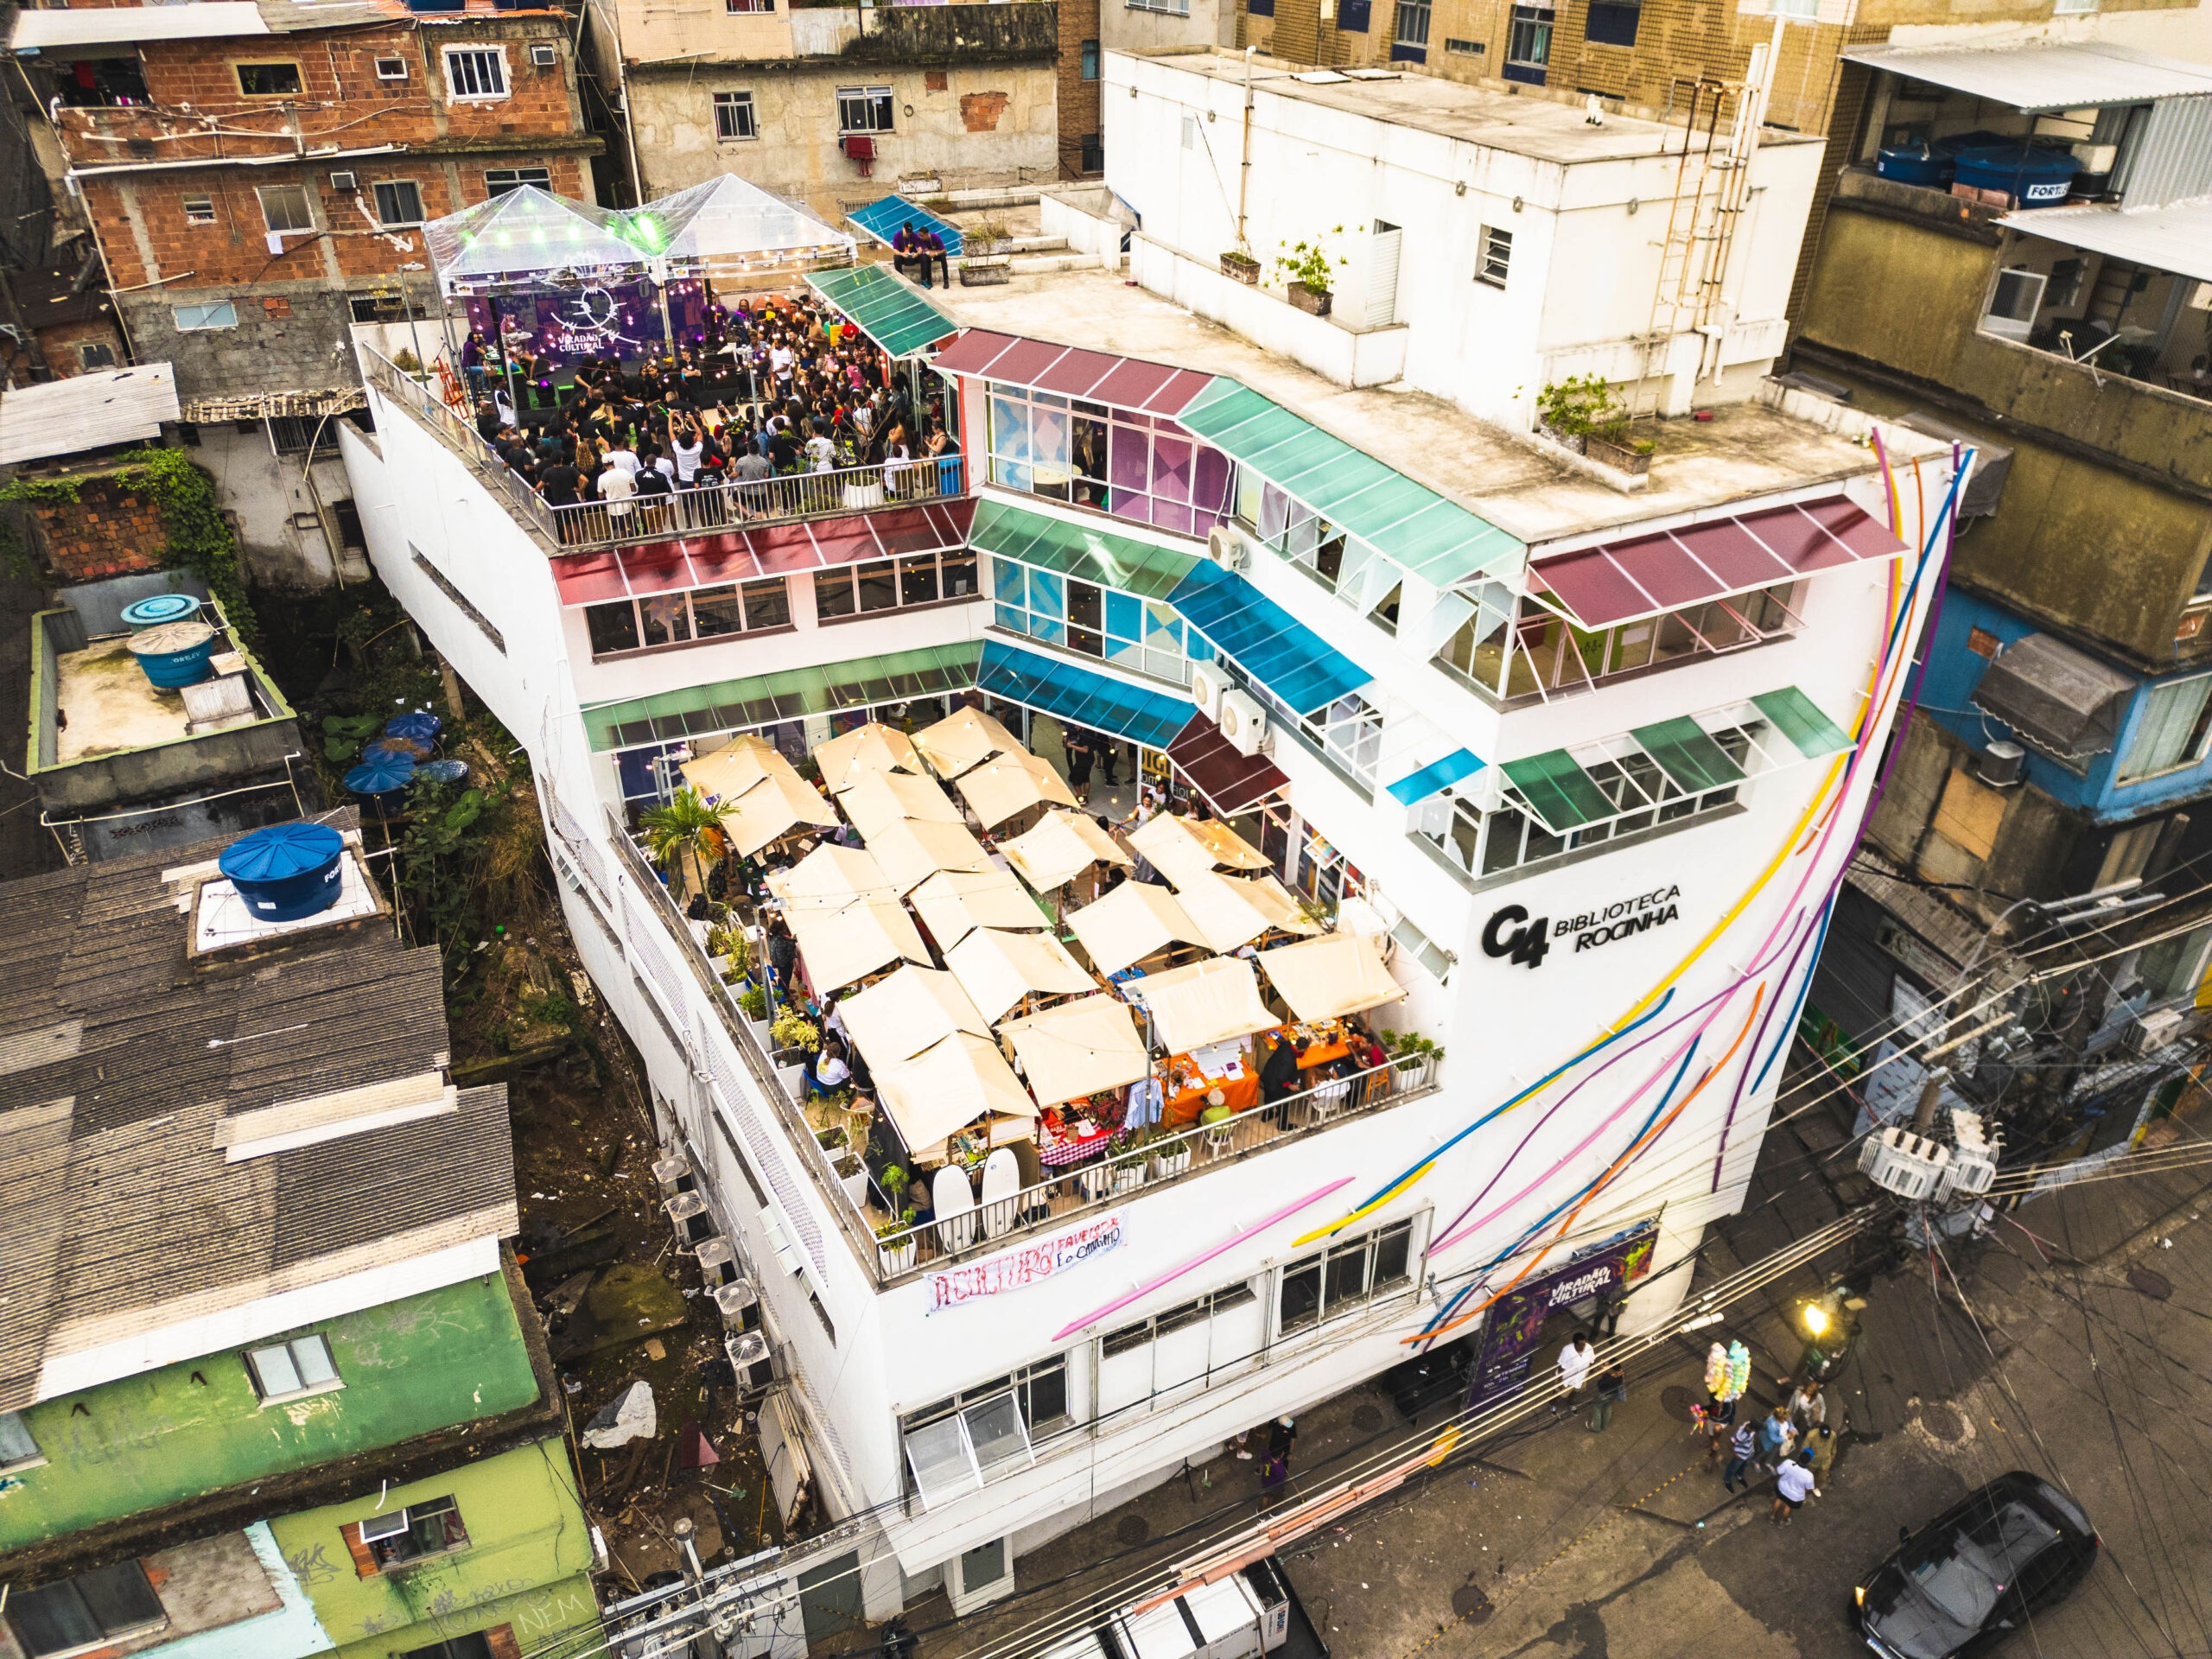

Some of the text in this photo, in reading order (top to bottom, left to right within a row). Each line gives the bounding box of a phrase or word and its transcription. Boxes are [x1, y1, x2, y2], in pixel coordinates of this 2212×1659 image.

[171, 651, 200, 664] ORTLEV
[1553, 885, 1681, 938] BIBLIOTECA
[1575, 904, 1679, 953] ROCINHA
[1548, 1270, 1611, 1307] CULTURAL
[1552, 1266, 1609, 1298] VIRADÃO
[518, 1593, 588, 1634] NEM
